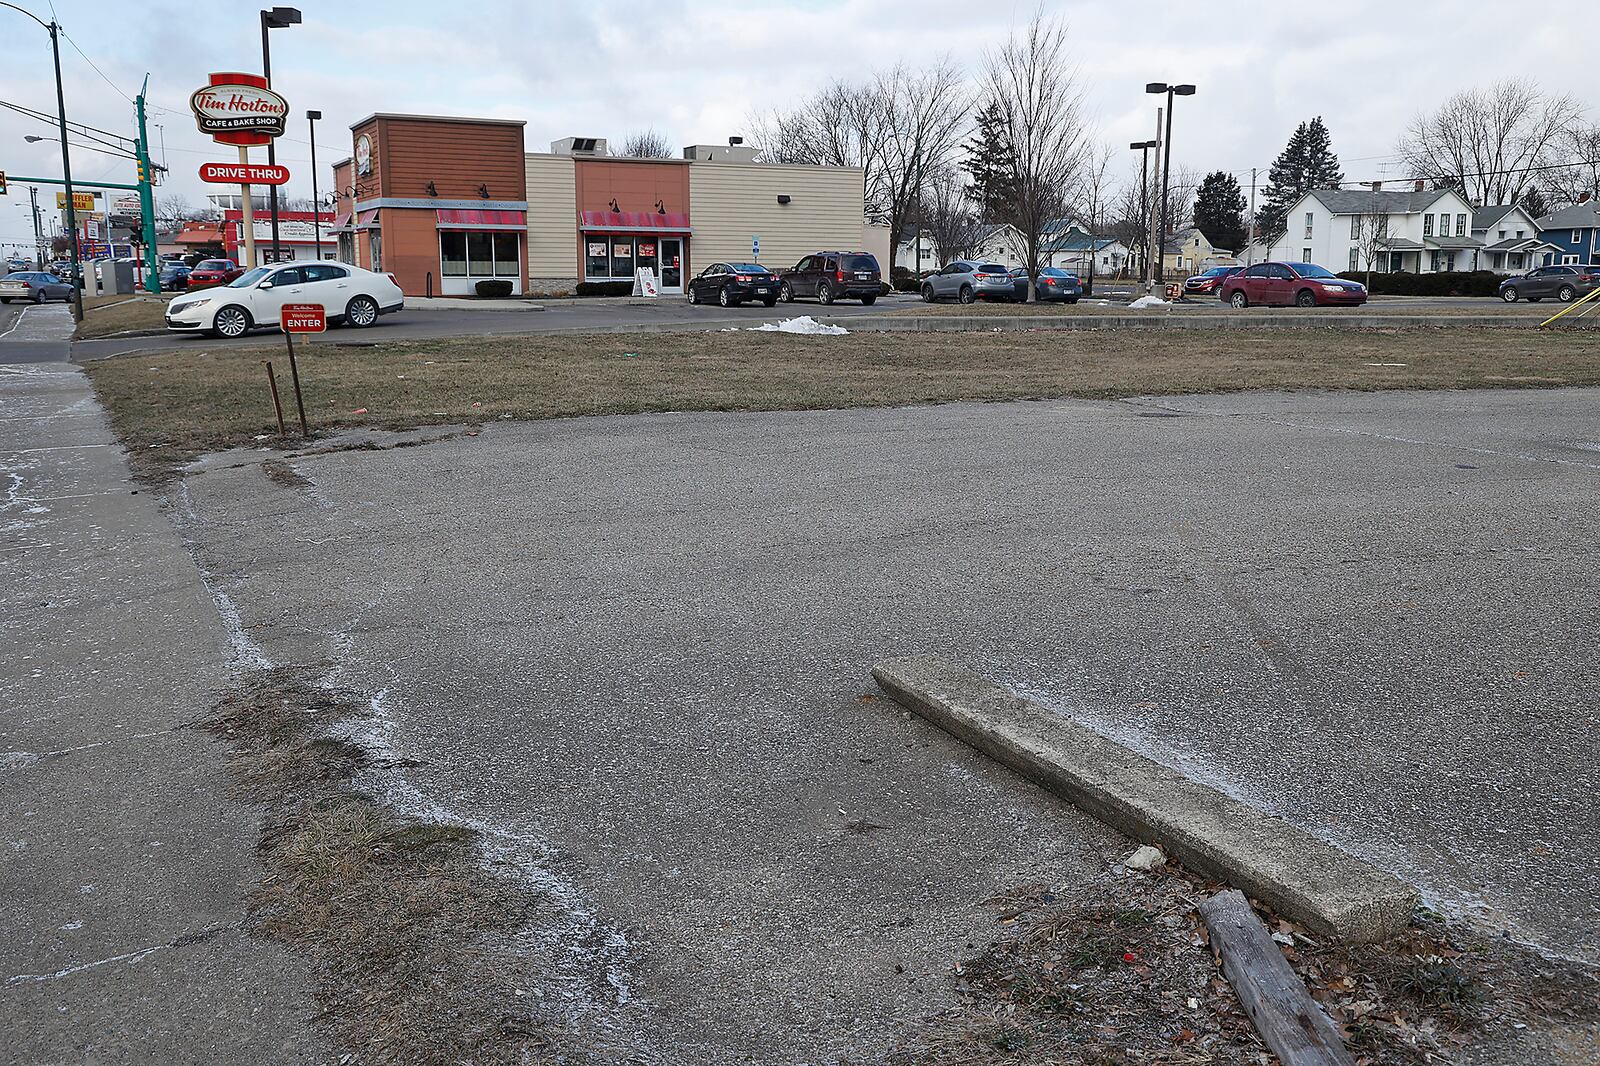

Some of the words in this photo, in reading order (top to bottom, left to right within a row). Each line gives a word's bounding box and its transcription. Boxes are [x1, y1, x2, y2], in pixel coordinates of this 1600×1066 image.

[196, 92, 225, 110] Tim
[228, 94, 284, 113] Hortons
[207, 167, 246, 178] DRIVE
[248, 168, 282, 179] THRU
